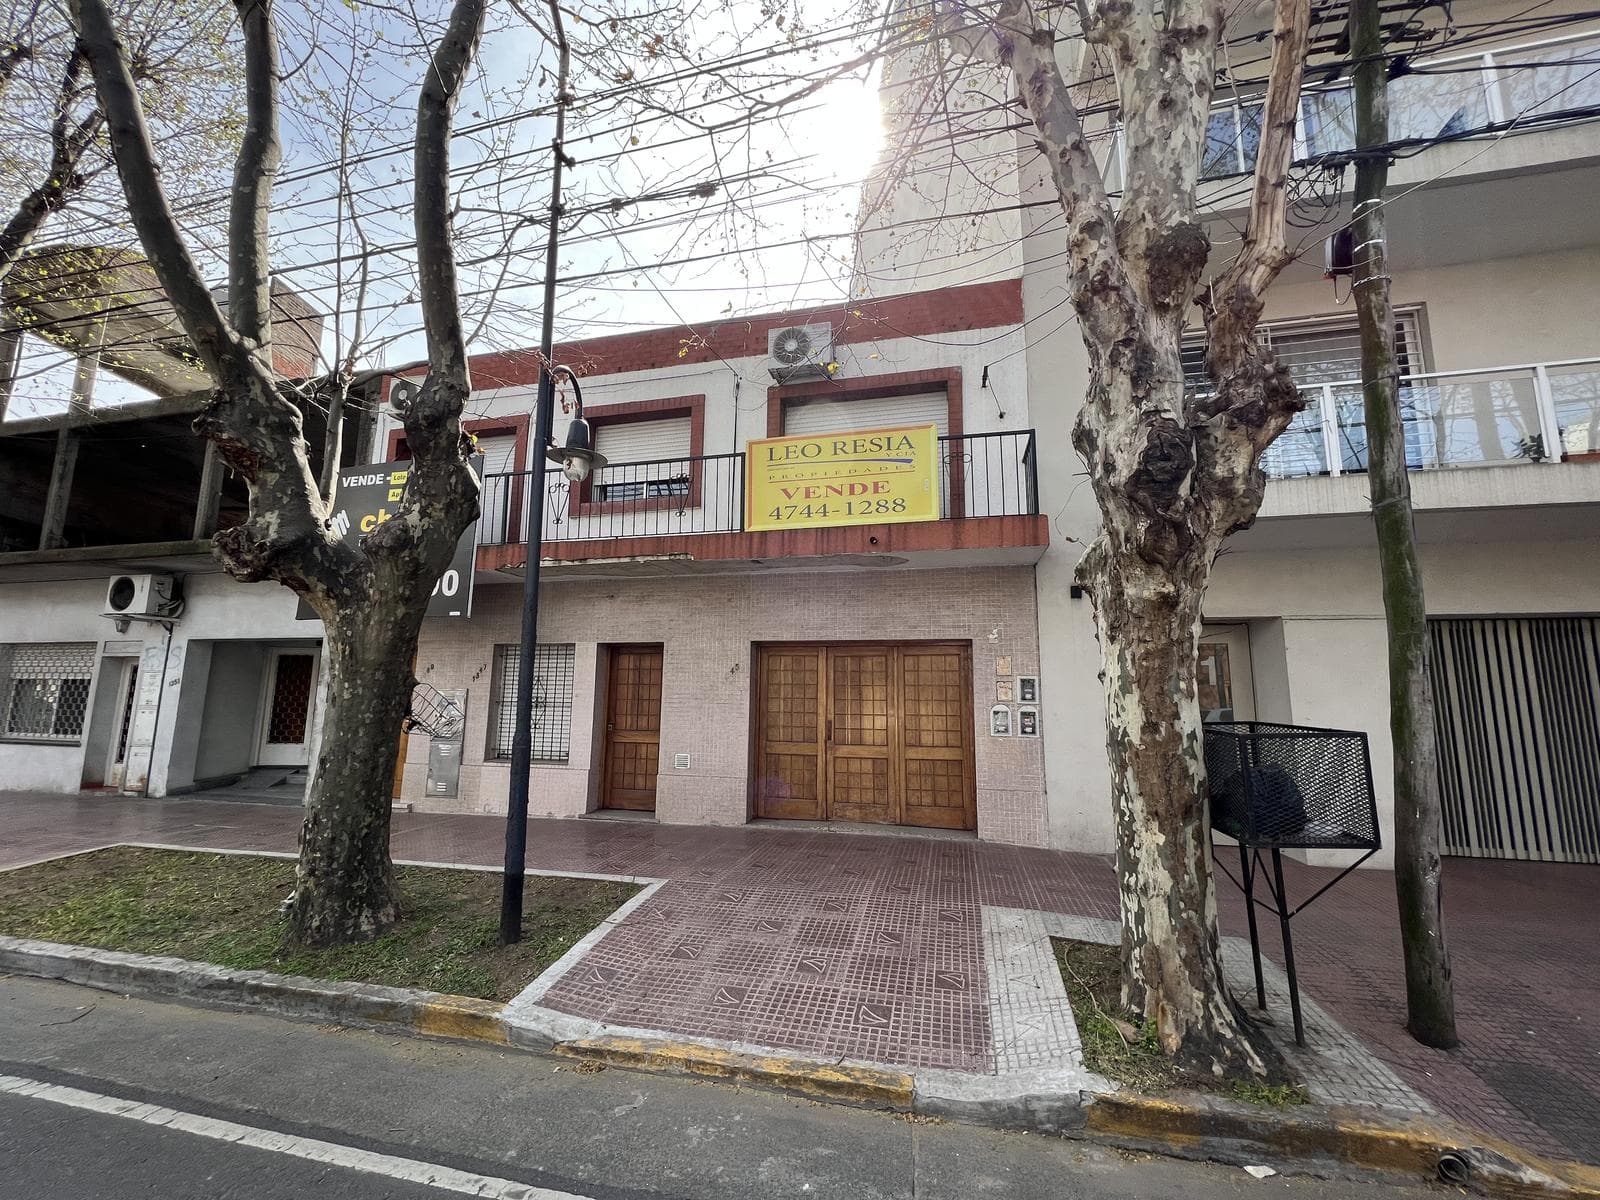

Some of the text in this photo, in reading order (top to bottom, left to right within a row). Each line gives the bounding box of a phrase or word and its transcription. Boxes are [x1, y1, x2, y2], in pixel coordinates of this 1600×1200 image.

[767, 434, 916, 462] LEO RESIA
[342, 473, 385, 488] VENDE
[769, 464, 916, 481] PROPIEDADES
[780, 480, 891, 501] VENDE
[768, 497, 907, 521] 4744-1288
